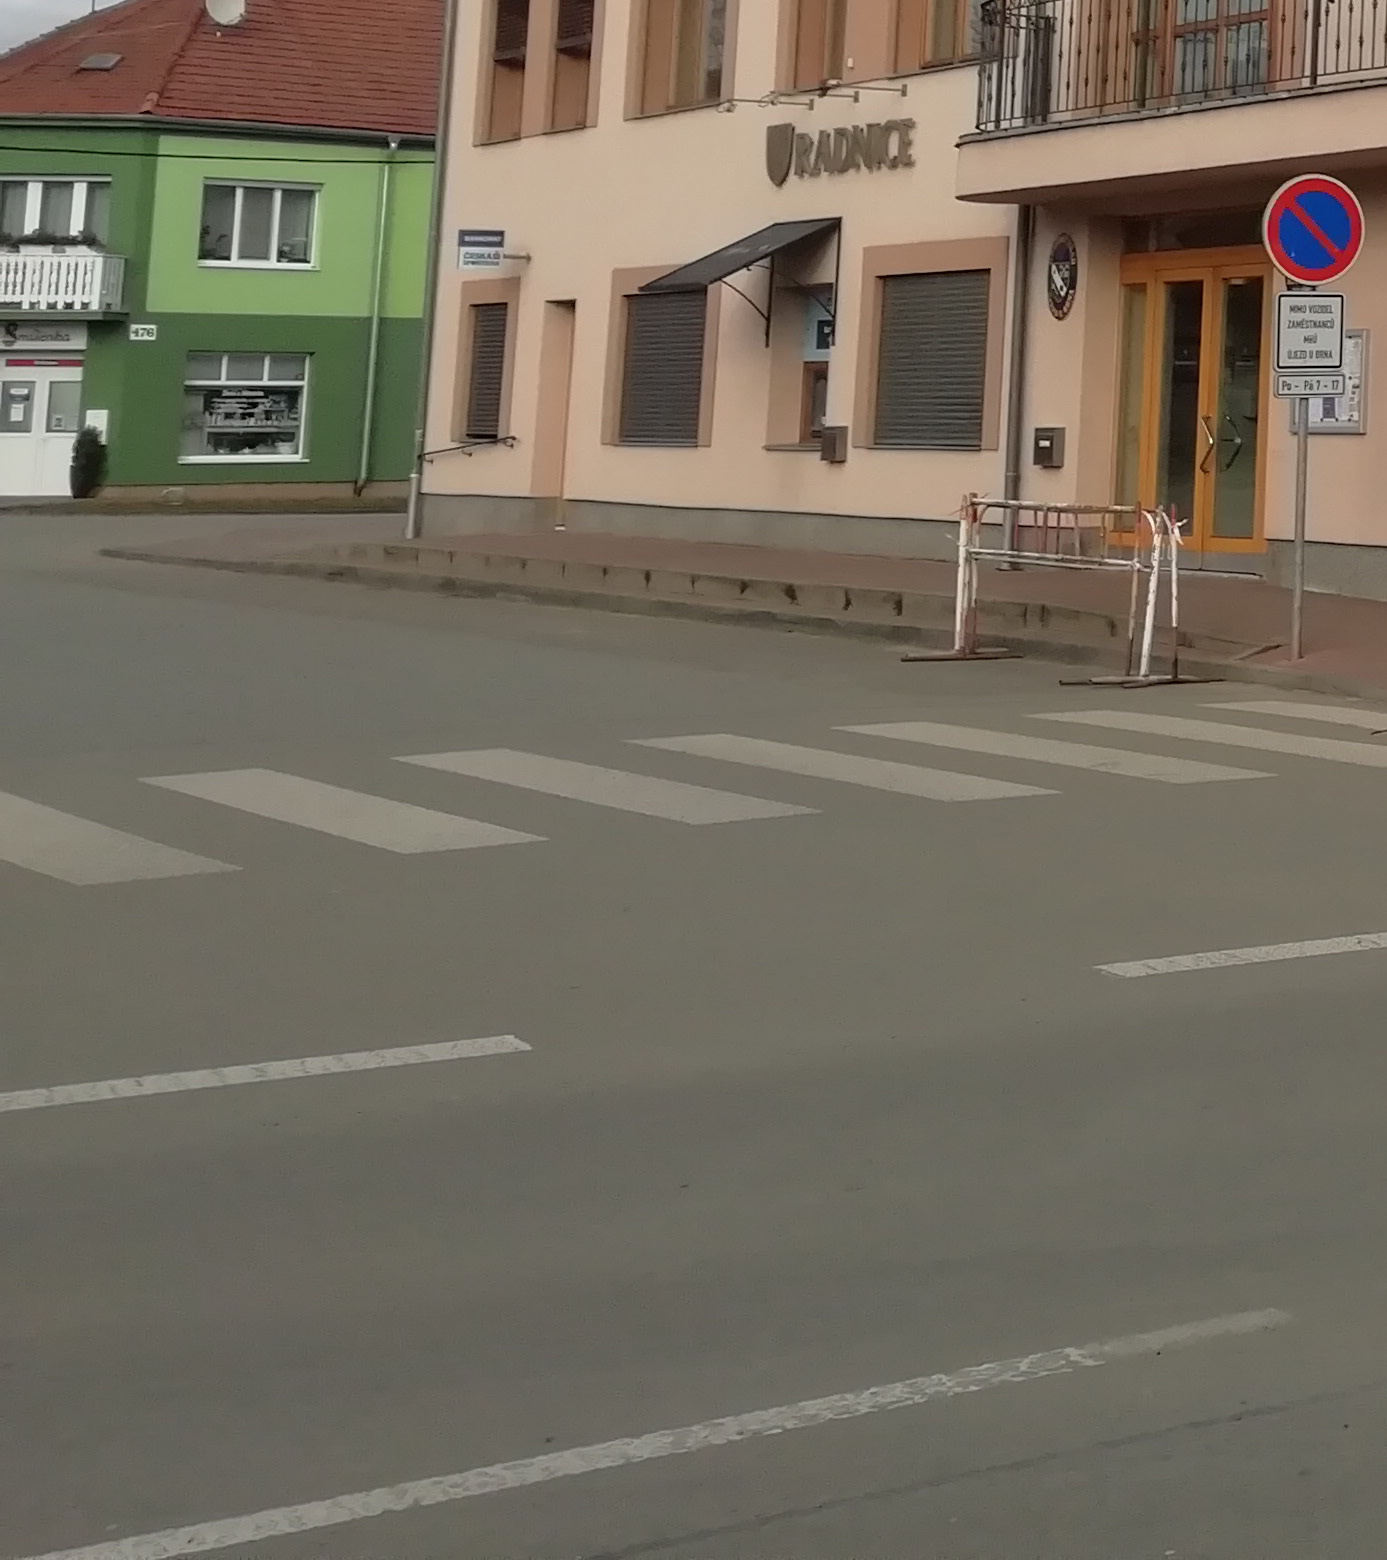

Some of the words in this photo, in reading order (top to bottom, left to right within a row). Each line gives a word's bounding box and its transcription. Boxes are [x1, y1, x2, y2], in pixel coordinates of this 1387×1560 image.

[794, 118, 915, 178] RADNICE
[1289, 304, 1307, 314] MIMO
[1309, 304, 1333, 314] VOZIDEL
[131, 327, 155, 338] 476
[1315, 350, 1333, 360] BRNA
[1281, 380, 1292, 391] Po
[1316, 380, 1321, 391] 7
[1331, 380, 1340, 391] 17
